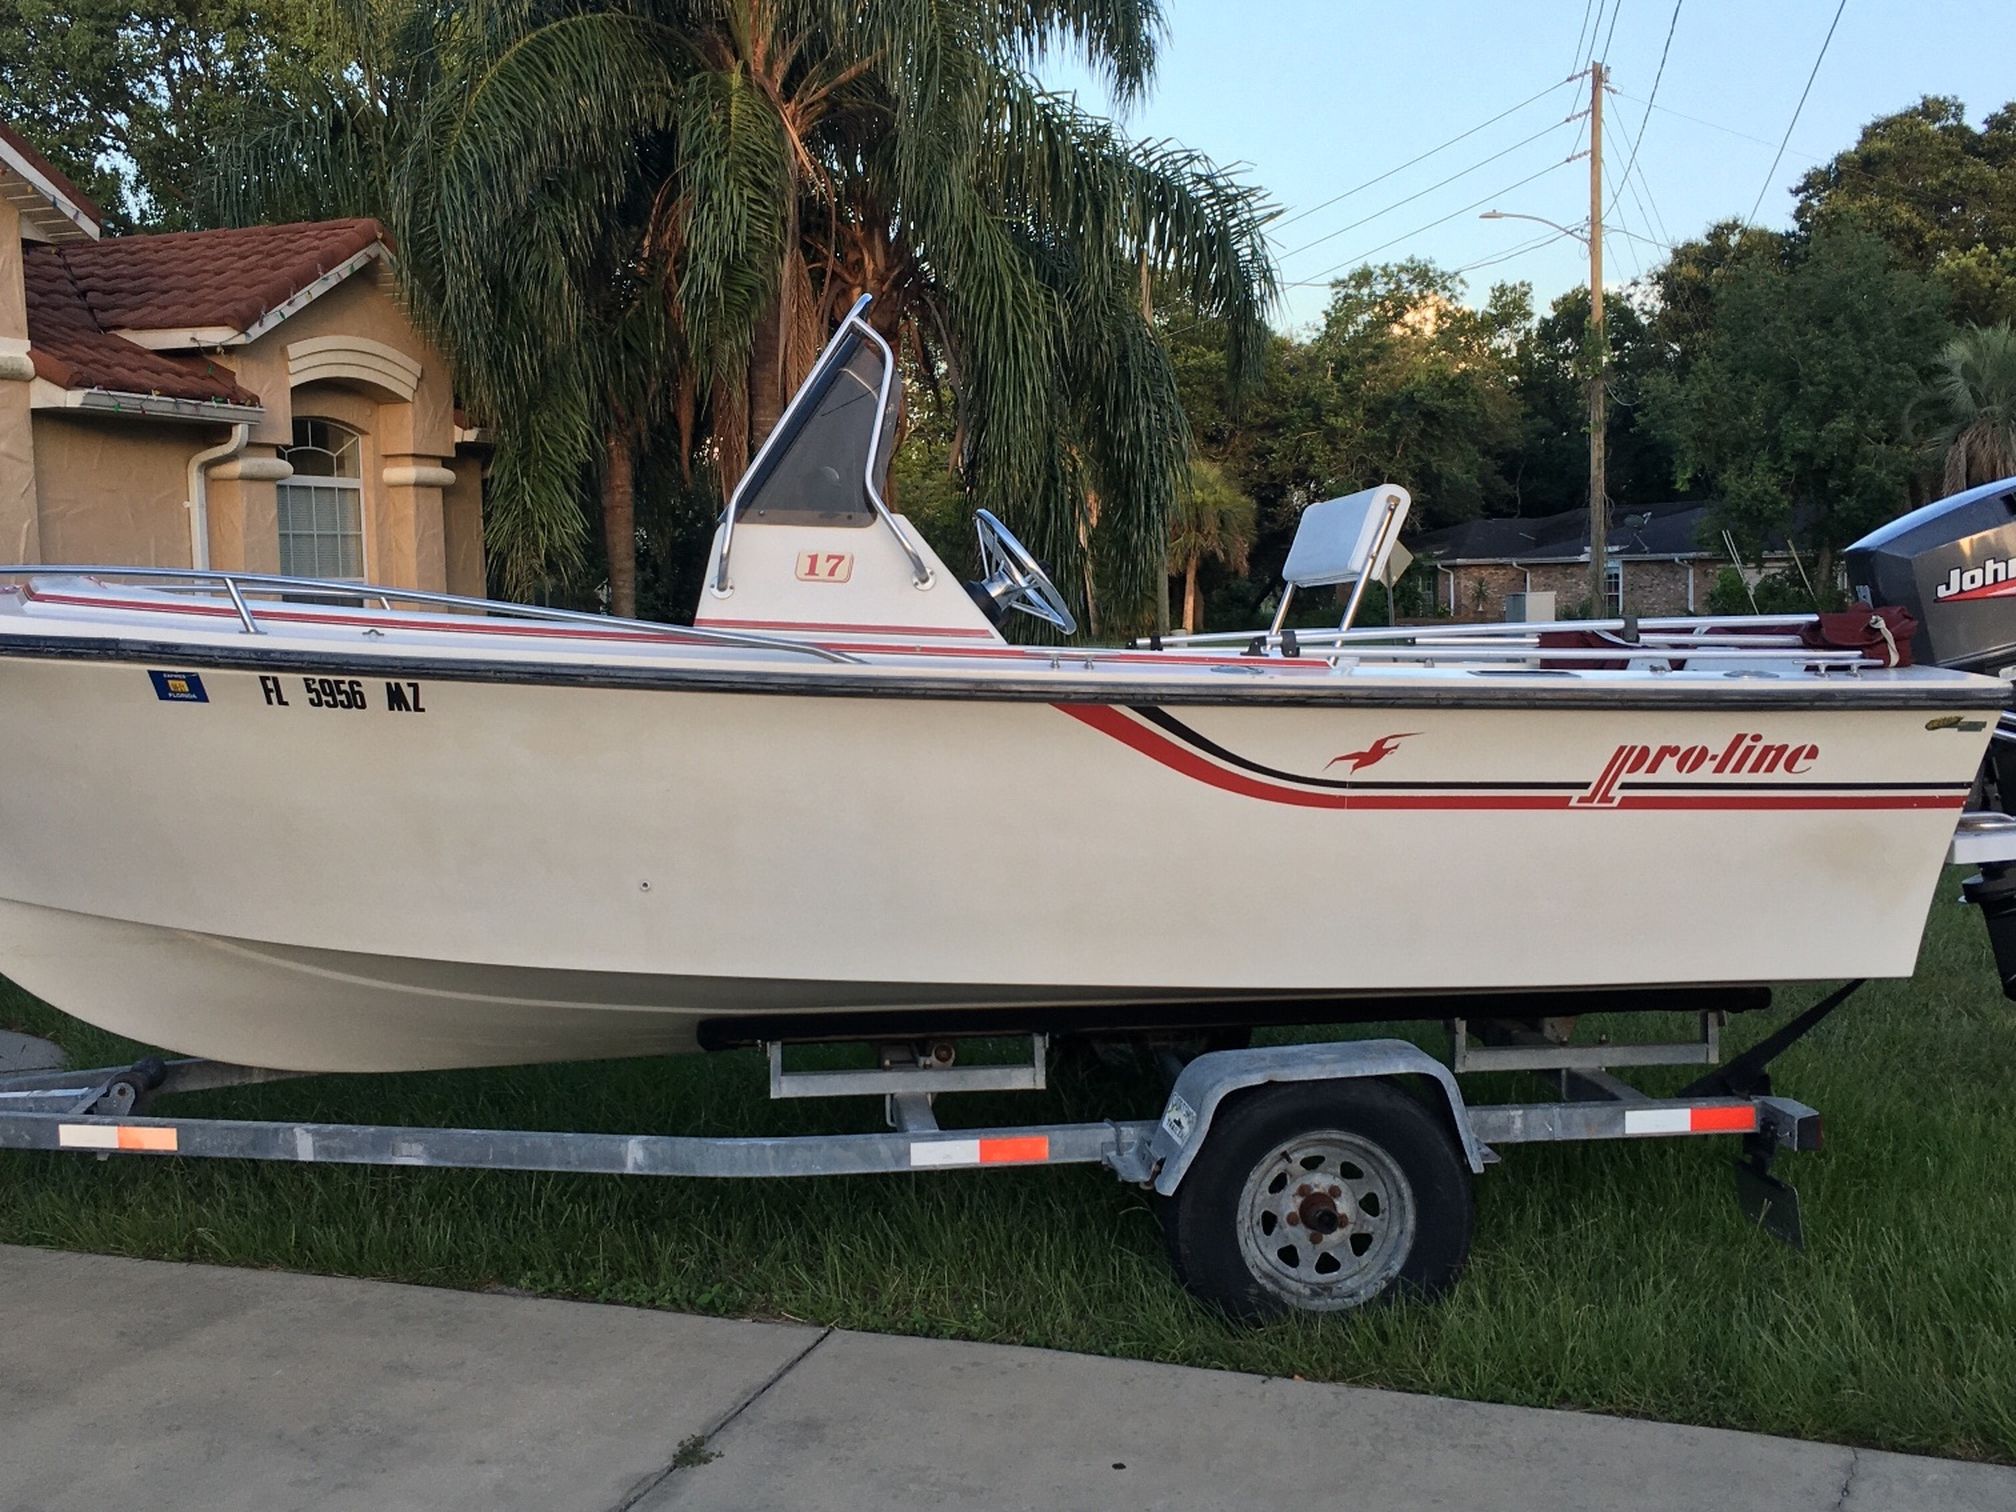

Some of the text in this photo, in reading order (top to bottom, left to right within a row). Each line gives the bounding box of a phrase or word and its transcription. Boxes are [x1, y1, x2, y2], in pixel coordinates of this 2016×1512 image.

[804, 553, 845, 577] 17
[259, 675, 426, 713] FL 5956 MZ
[1577, 733, 1819, 804] pro-line
